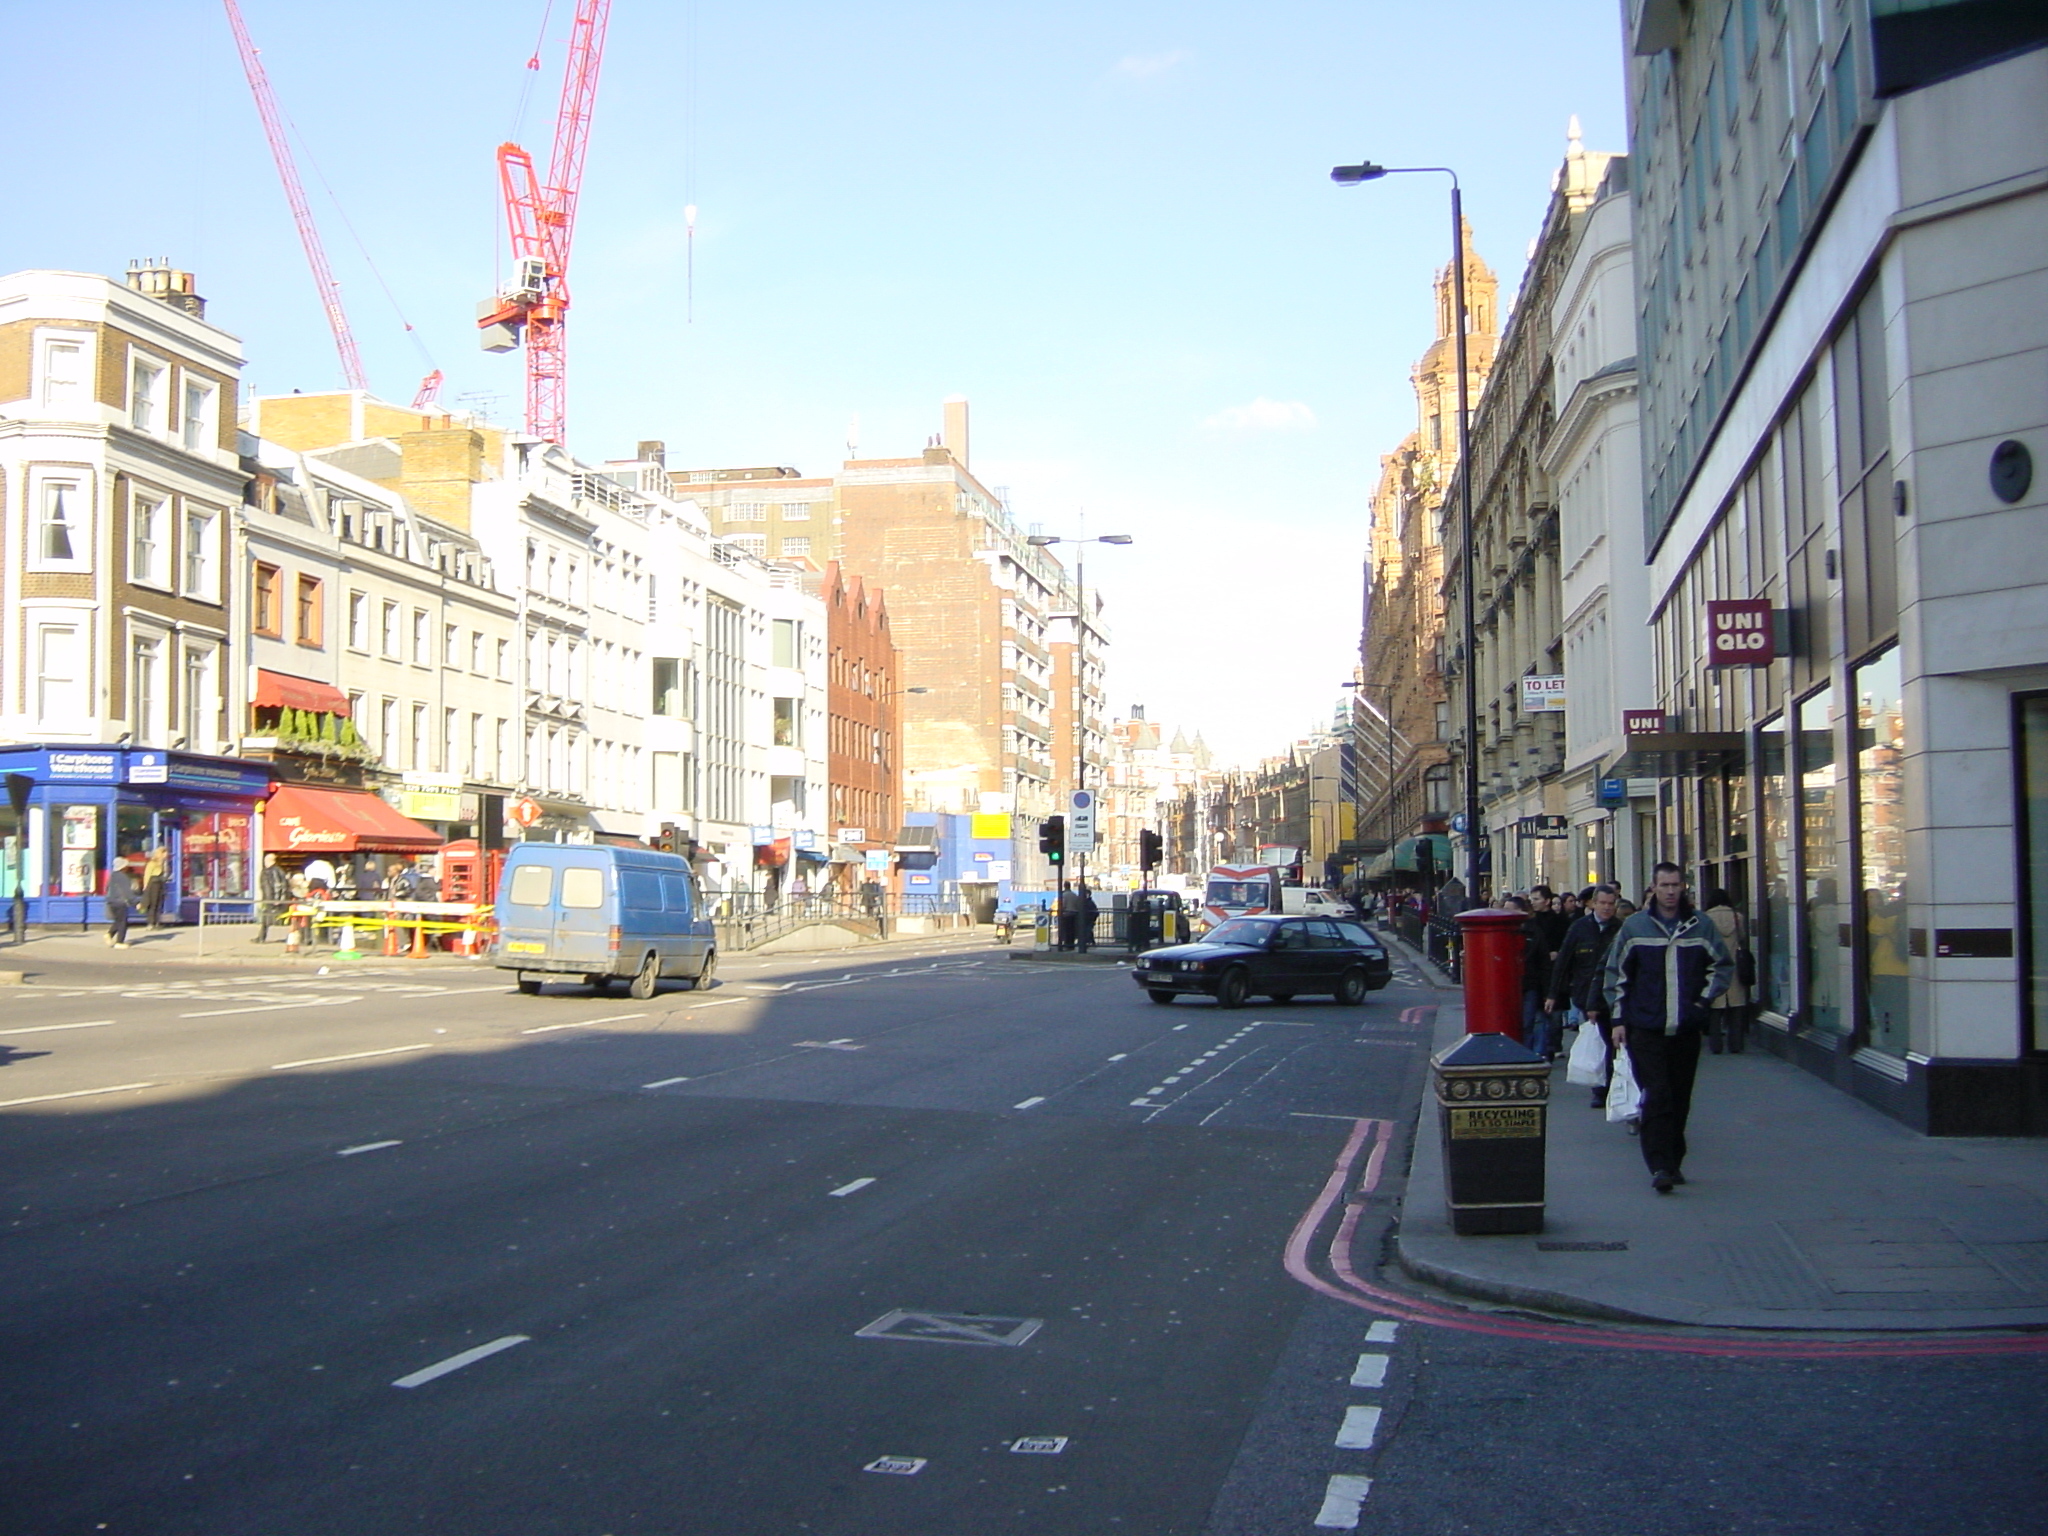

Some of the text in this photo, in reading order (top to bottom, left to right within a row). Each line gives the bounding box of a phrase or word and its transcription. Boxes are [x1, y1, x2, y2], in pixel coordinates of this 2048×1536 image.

[1716, 612, 1762, 630] UNI
[1716, 632, 1765, 650] QLO
[1525, 680, 1565, 690] TO LET
[1629, 718, 1659, 729] UNI
[1468, 1109, 1535, 1120] RECYCLING
